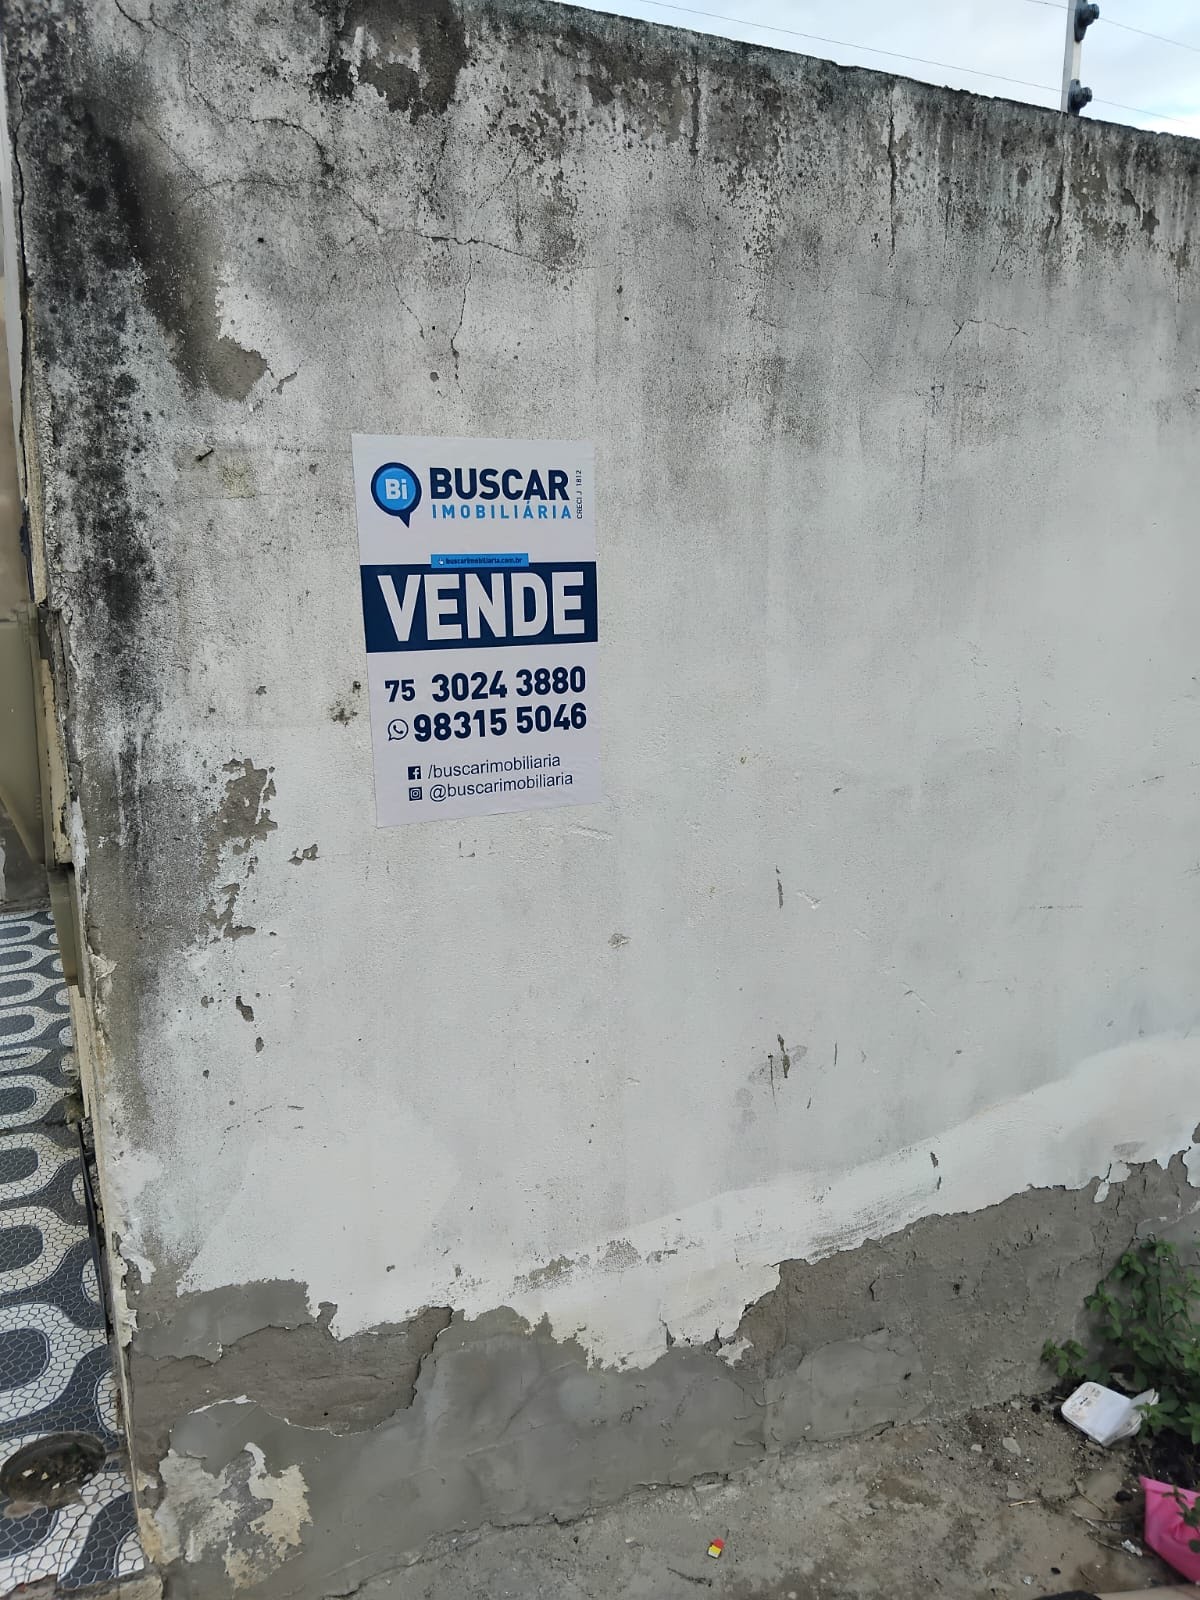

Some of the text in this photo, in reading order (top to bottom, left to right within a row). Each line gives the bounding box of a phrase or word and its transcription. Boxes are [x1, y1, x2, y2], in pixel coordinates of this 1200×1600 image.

[385, 478, 408, 500] Bi
[429, 467, 570, 501] BUSCAR
[431, 500, 572, 519] IMOBILIÁRIA
[445, 556, 523, 565] buscarimobiliaria.com.br
[377, 571, 585, 642] VENDE
[384, 666, 586, 702] 75 3024 3880
[413, 702, 587, 742] 98315 5046
[427, 754, 561, 779] /buscarimobiliaria
[429, 772, 573, 802] @buscarimobiliaria
